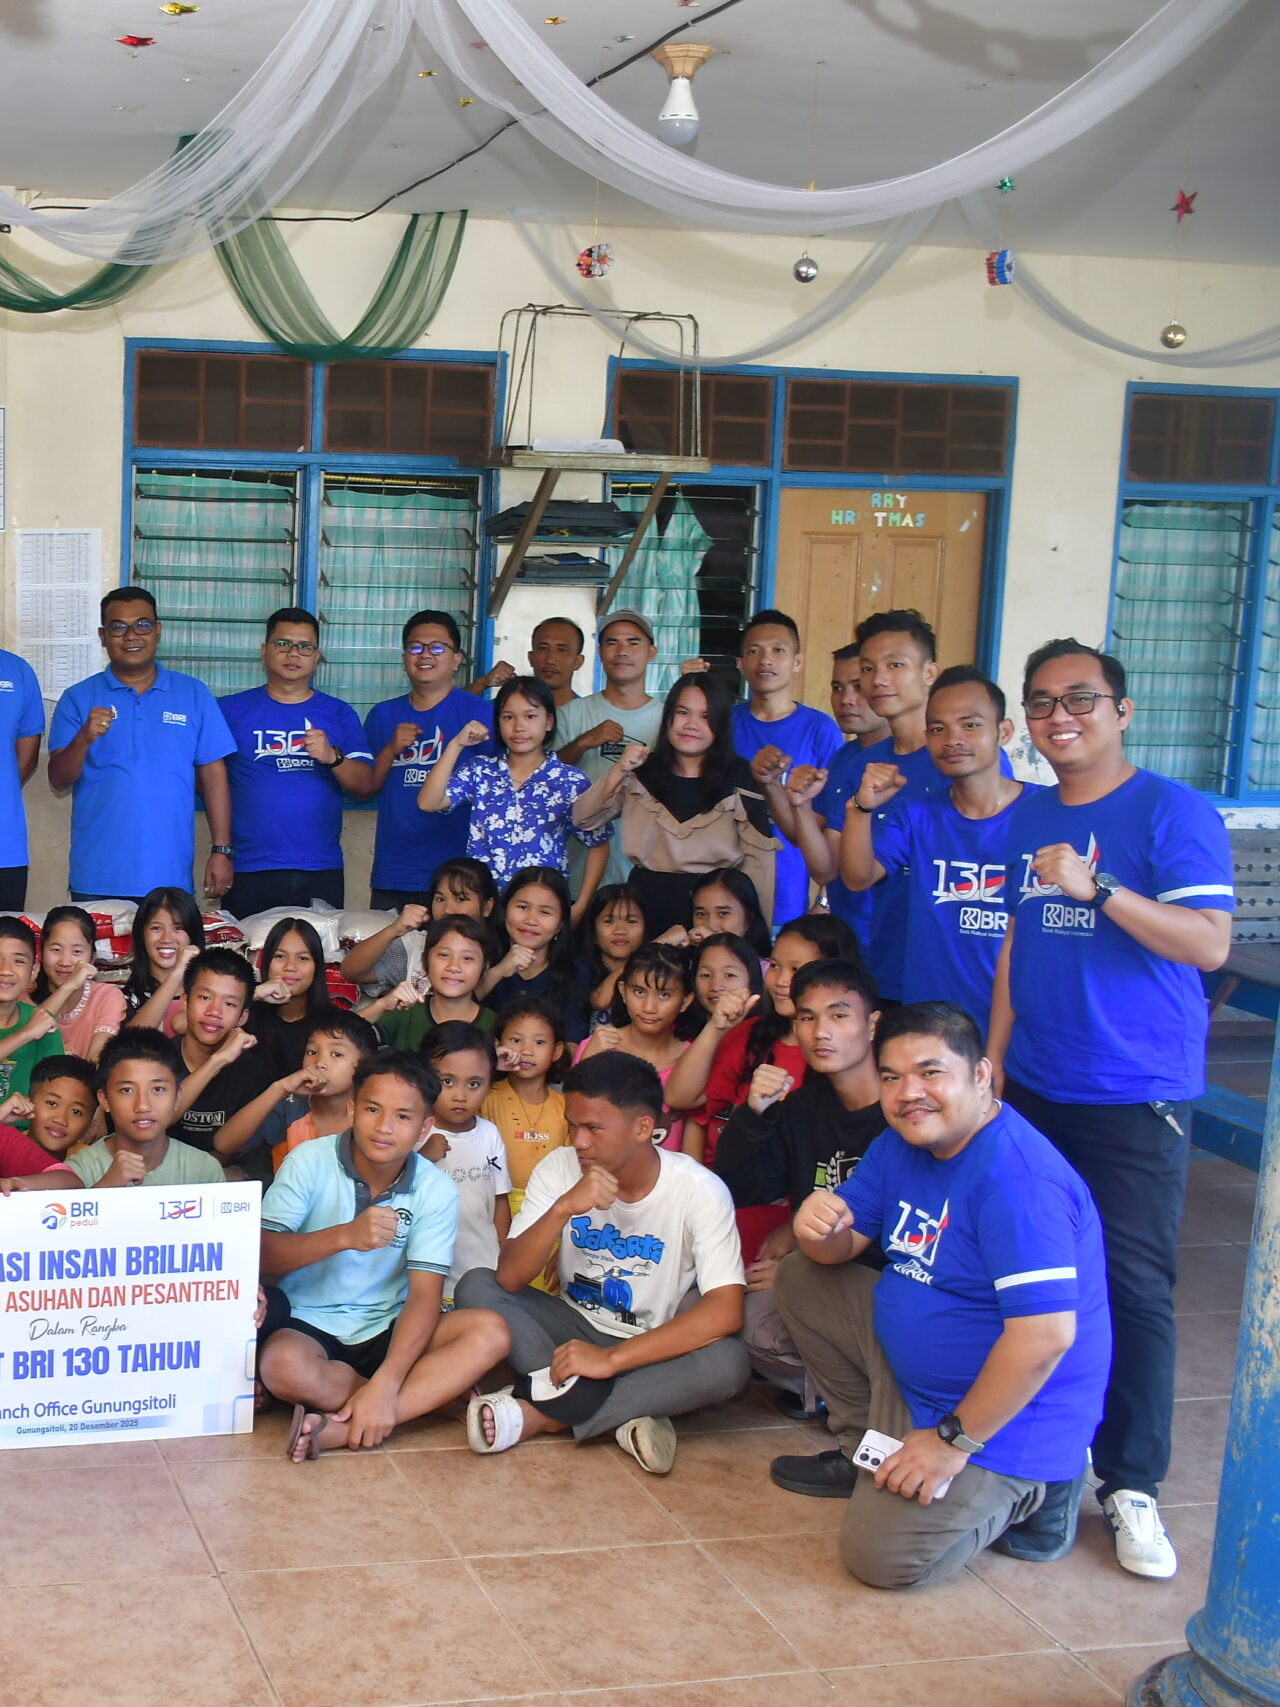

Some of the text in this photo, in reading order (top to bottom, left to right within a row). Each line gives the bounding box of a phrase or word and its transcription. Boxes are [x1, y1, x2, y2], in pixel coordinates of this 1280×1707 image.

[831, 510, 926, 527] HR TMAS
[981, 911, 1009, 930] BR
[1064, 907, 1095, 929] BRI
[183, 1111, 222, 1123] OSTON
[524, 1132, 549, 1140] BOSS
[71, 1201, 99, 1217] BRI
[234, 1202, 250, 1212] BRI
[70, 1218, 99, 1228] peduli
[39, 1247, 116, 1281] INSAN
[126, 1242, 223, 1276] BRILIAN
[5, 1288, 83, 1313] ASUHAN
[88, 1285, 126, 1308] DAN
[131, 1279, 240, 1306] PESANTREN
[28, 1315, 128, 1341] Dalam Rangka
[13, 1350, 54, 1380] BRI
[62, 1345, 109, 1377] 130
[118, 1340, 201, 1374] TAHUN
[34, 1401, 78, 1418] Office
[81, 1393, 177, 1415] Gunungsitoli
[16, 1422, 67, 1435] Gunungsitoli,
[80, 1420, 118, 1431] Desember
[120, 1419, 138, 1428] 2025
